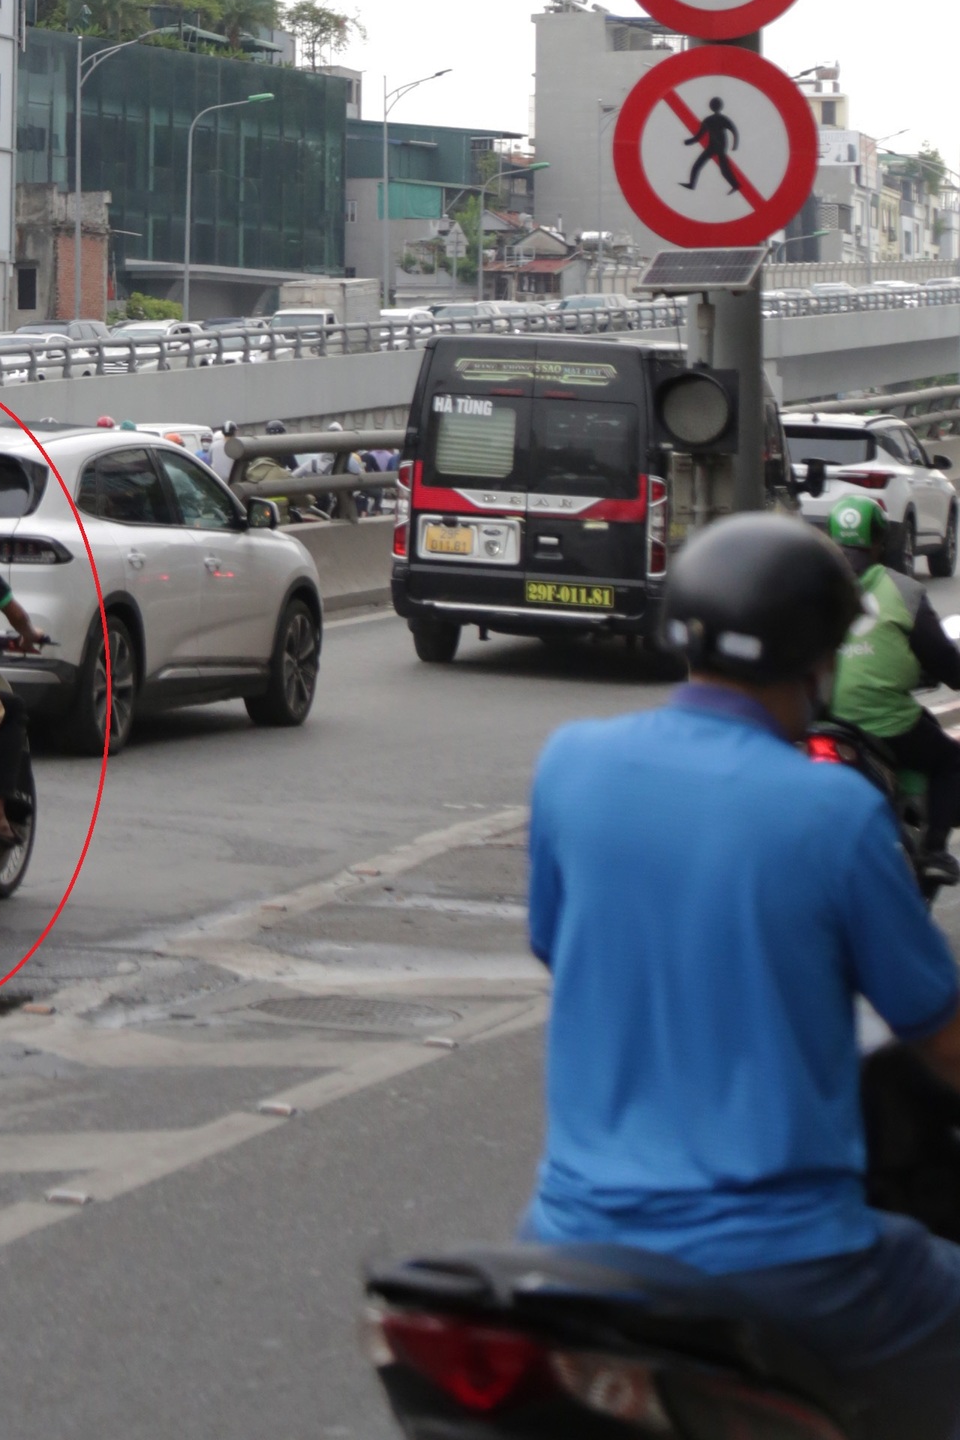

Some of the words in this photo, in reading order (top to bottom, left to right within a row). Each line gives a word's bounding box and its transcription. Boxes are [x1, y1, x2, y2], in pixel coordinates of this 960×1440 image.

[542, 364, 561, 374] SAO
[433, 394, 453, 413] HÀ
[456, 395, 492, 416] TÙNG
[440, 528, 460, 539] 29F
[528, 584, 612, 606] 29F-011.81
